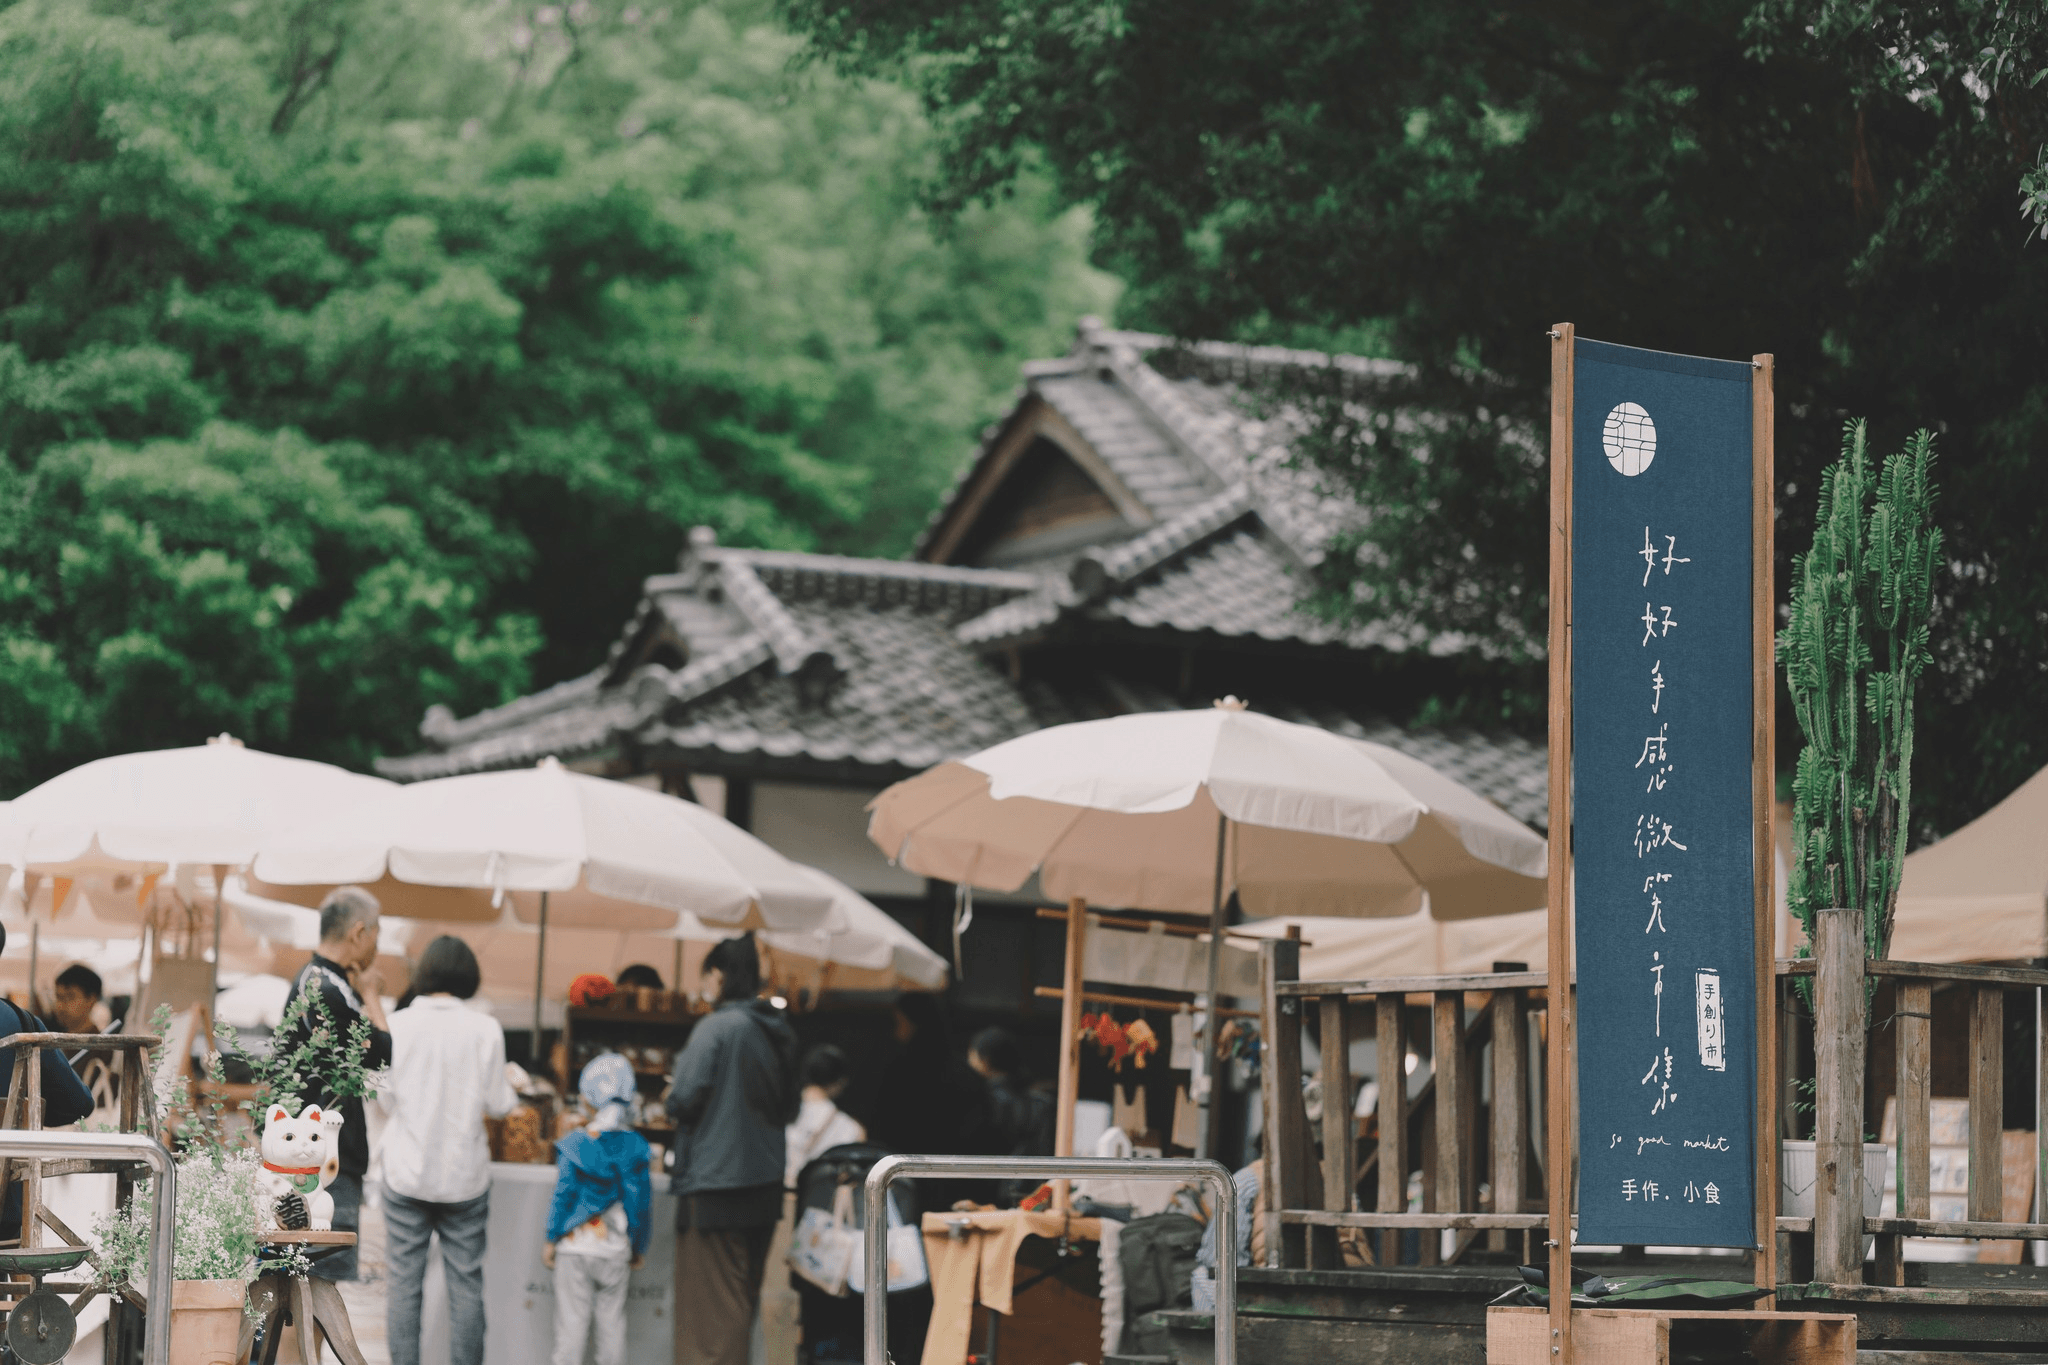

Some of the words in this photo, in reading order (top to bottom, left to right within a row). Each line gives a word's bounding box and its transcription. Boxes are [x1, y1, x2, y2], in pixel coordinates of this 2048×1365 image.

[1633, 525, 1691, 1116] 好好手感微笑市集
[1703, 983, 1718, 1060] 手創り市
[1637, 1135, 1672, 1156] good
[1683, 1134, 1730, 1152] market
